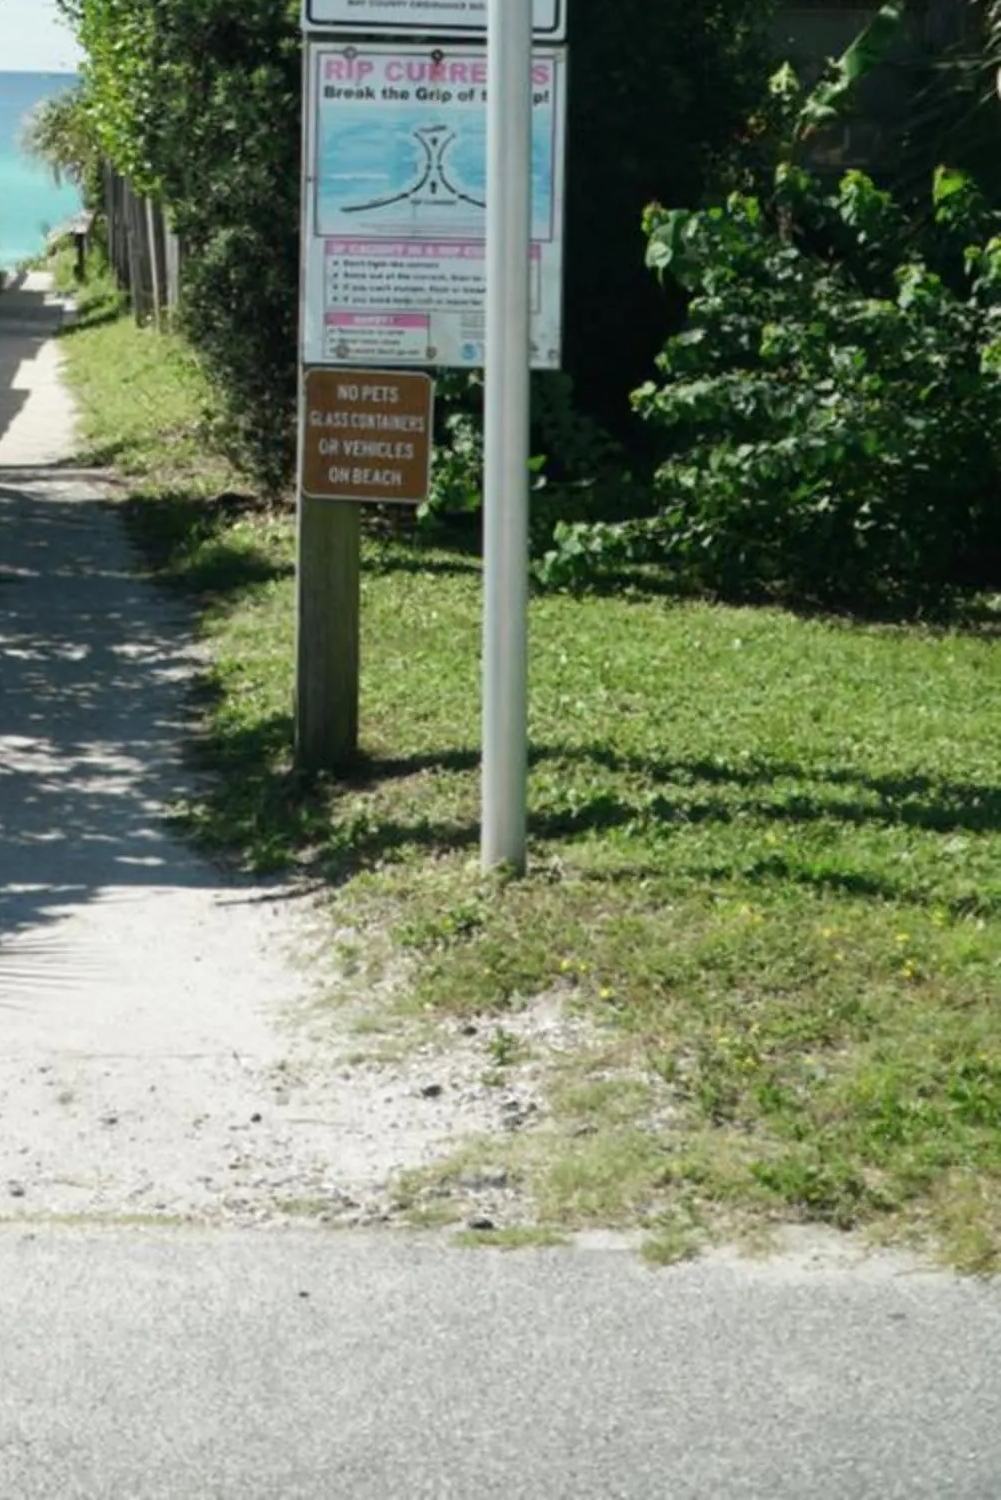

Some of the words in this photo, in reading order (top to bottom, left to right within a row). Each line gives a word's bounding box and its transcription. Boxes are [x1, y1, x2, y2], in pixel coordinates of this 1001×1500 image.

[325, 59, 374, 81] RIP
[384, 61, 550, 86] CURRES
[324, 86, 375, 100] Break
[381, 87, 409, 101] the
[415, 88, 452, 104] Grip
[457, 88, 475, 102] of
[337, 384, 359, 401] NO
[361, 385, 399, 403] PETS
[310, 411, 349, 428] GLASS
[350, 412, 425, 433] CONTAINERS
[318, 439, 340, 456] OR
[343, 440, 414, 460] VEHICLES
[328, 466, 352, 484] ON
[353, 468, 402, 486] BEACH
